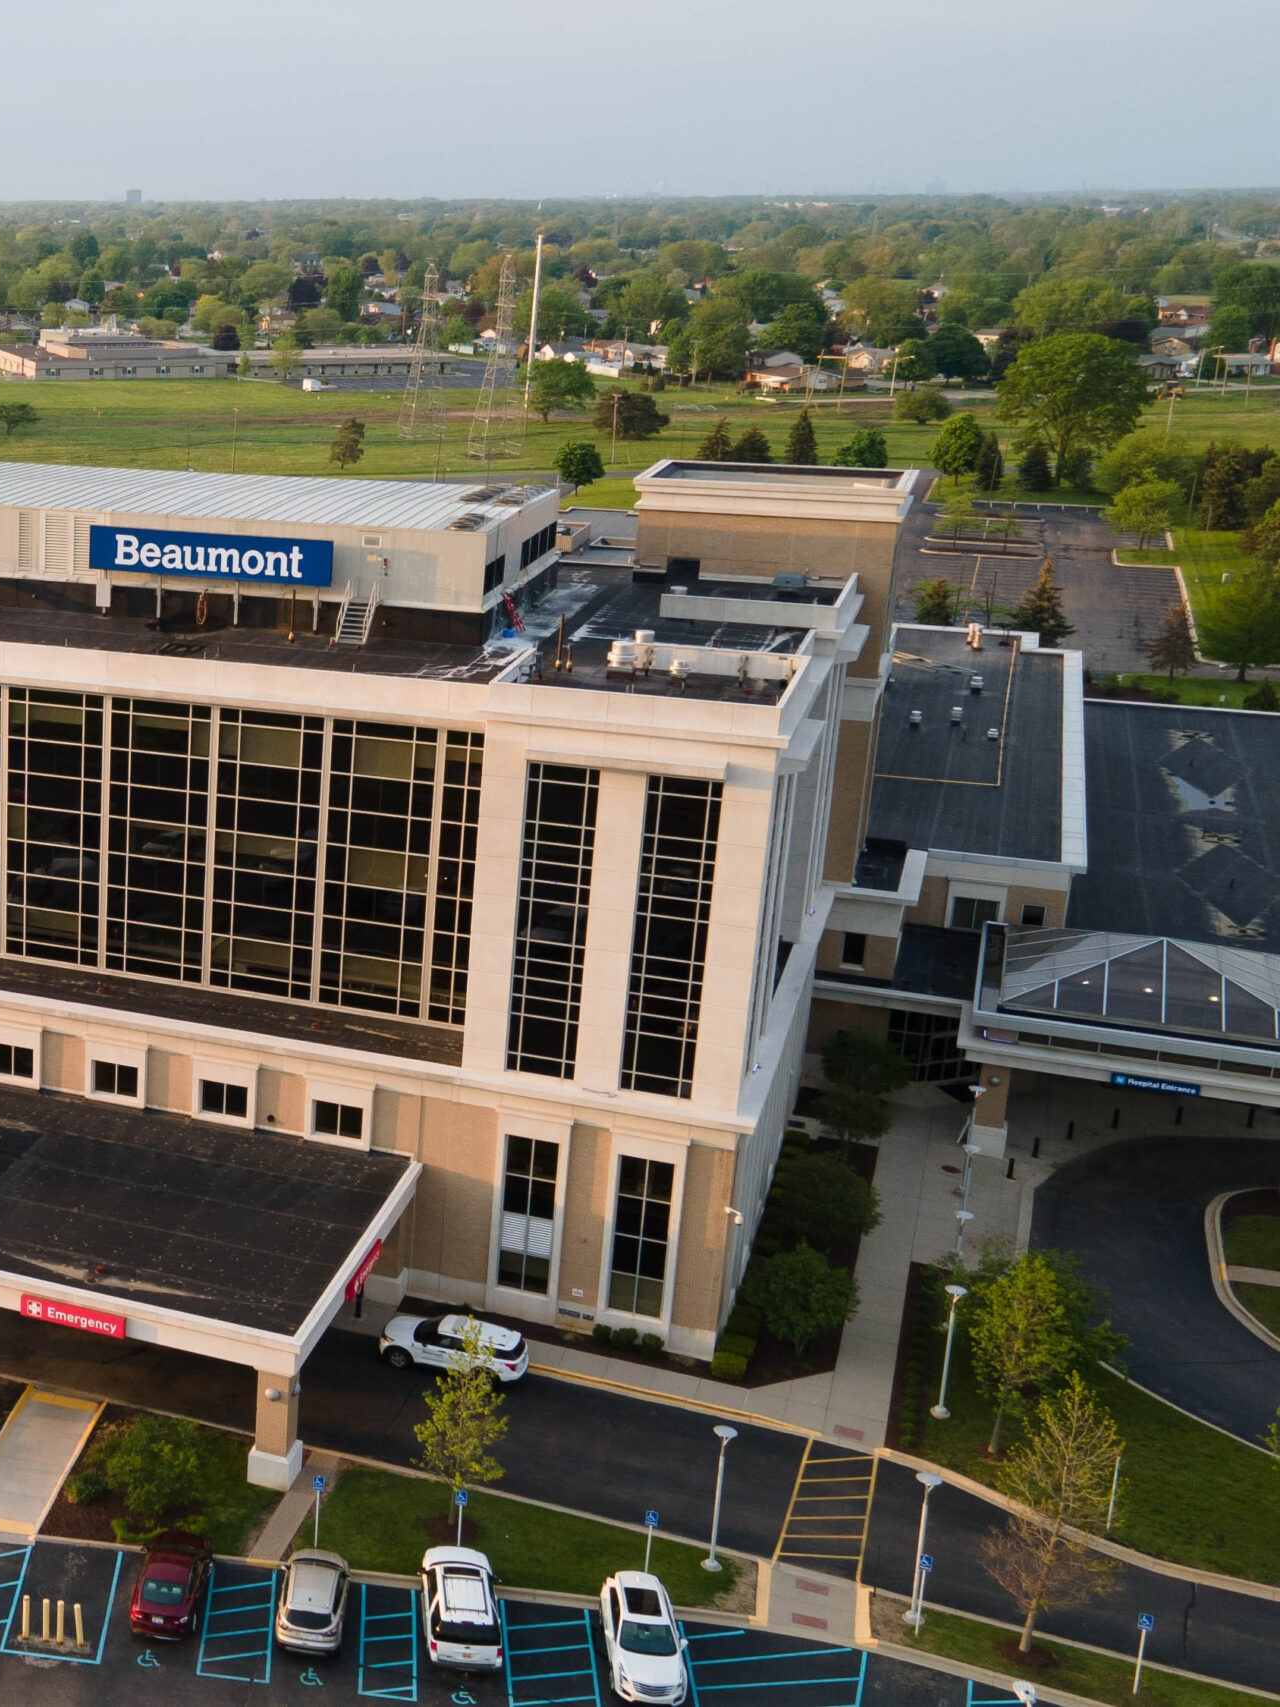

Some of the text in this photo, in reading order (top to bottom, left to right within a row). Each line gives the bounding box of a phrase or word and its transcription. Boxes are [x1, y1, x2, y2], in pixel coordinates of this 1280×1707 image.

[114, 533, 304, 579] Beaumont
[1127, 1078, 1160, 1089] Hospital
[1161, 1083, 1196, 1095] Entrance
[47, 1306, 117, 1335] Emergency
